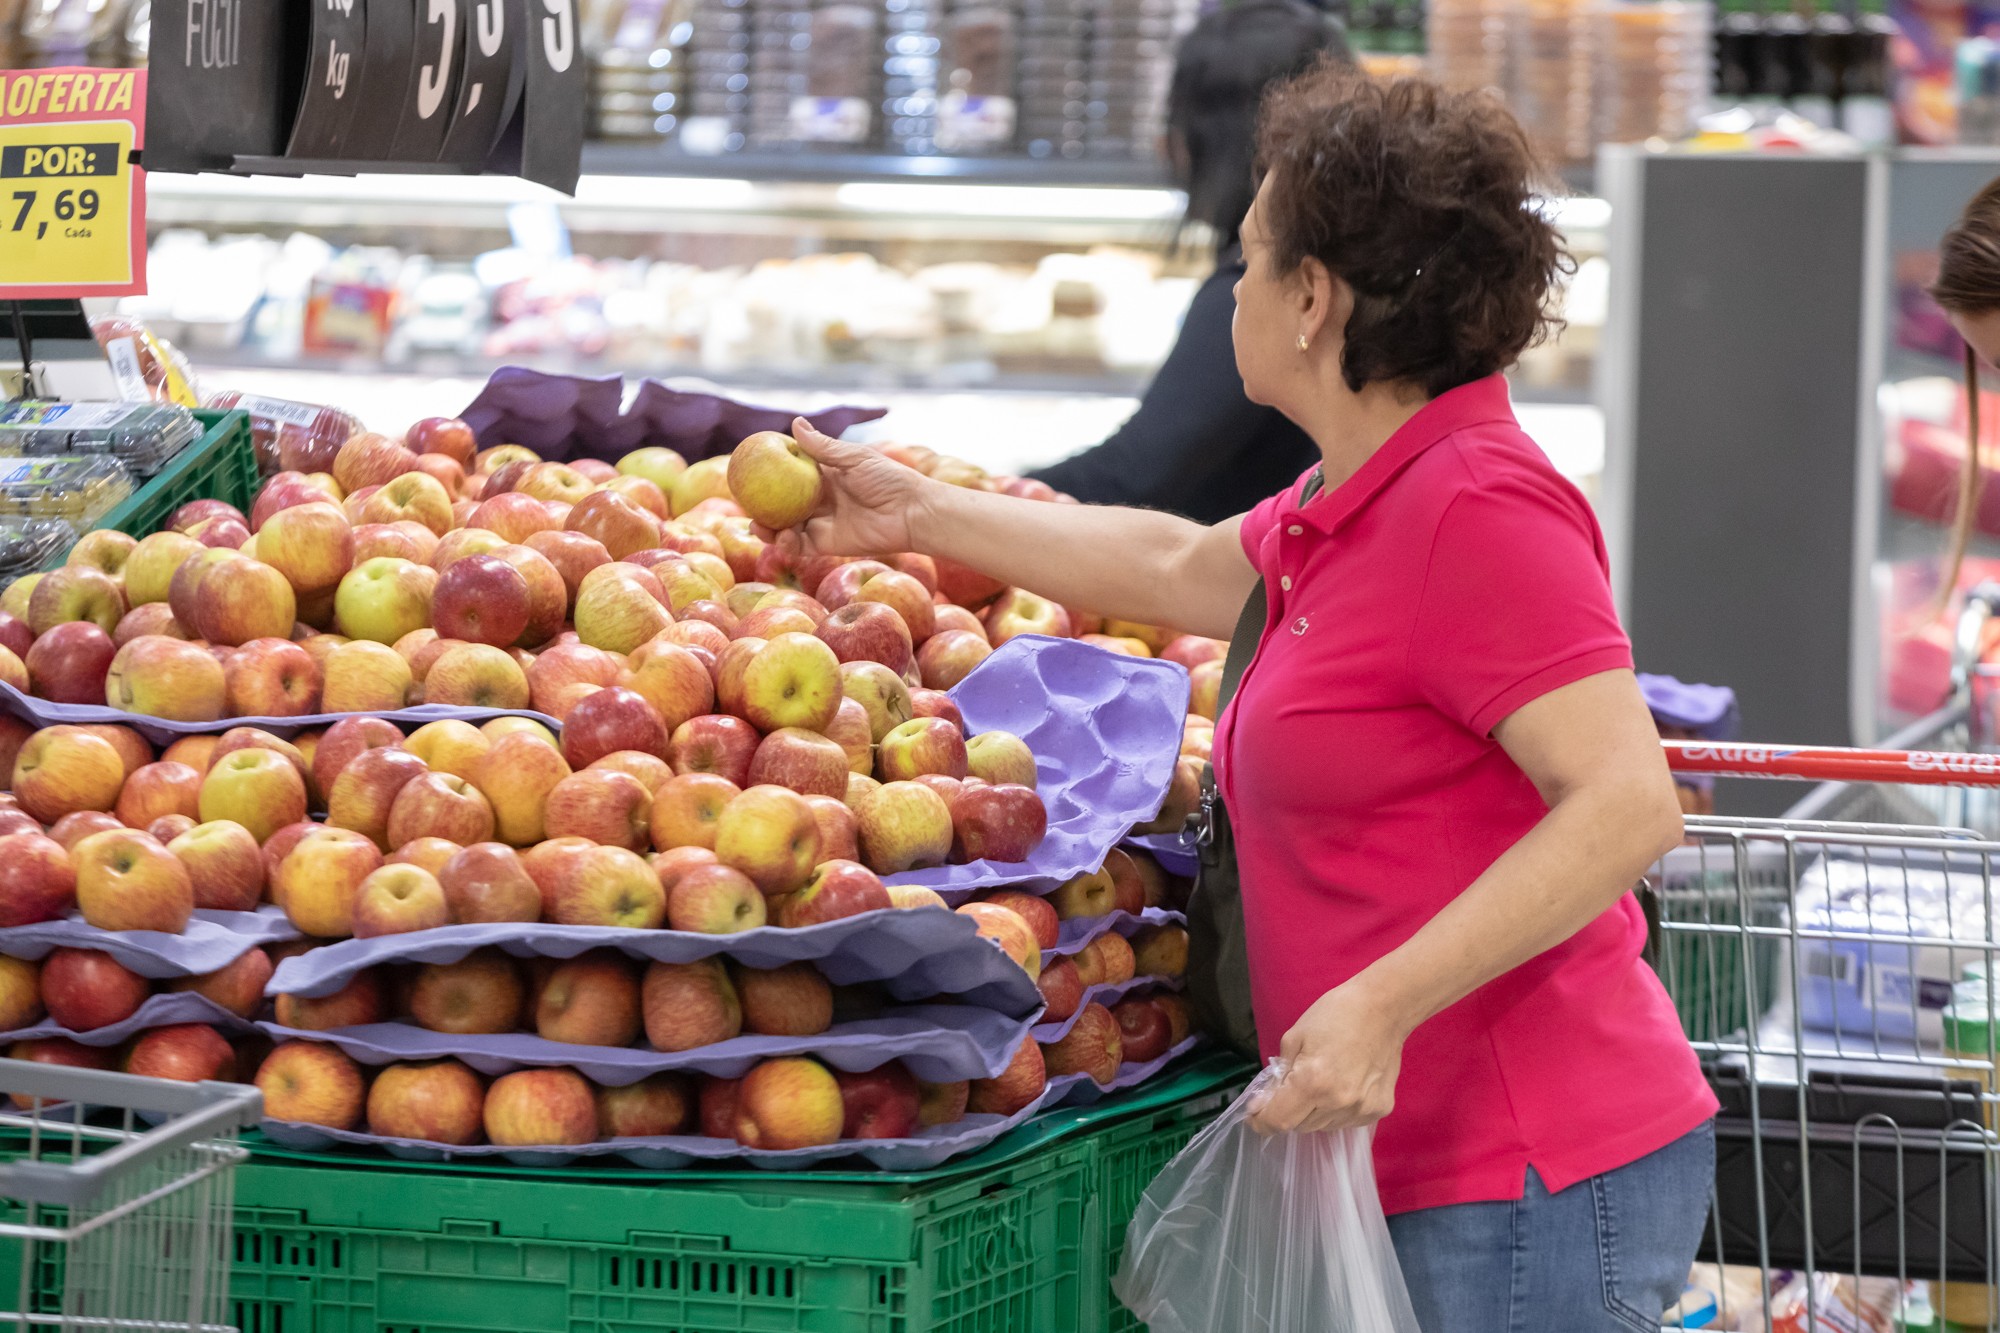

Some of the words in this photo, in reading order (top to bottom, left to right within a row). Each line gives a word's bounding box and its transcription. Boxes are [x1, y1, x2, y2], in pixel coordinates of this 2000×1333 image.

[325, 39, 350, 99] kg
[23, 146, 96, 175] POR:
[11, 189, 99, 240] 7,69
[65, 227, 92, 238] Cada
